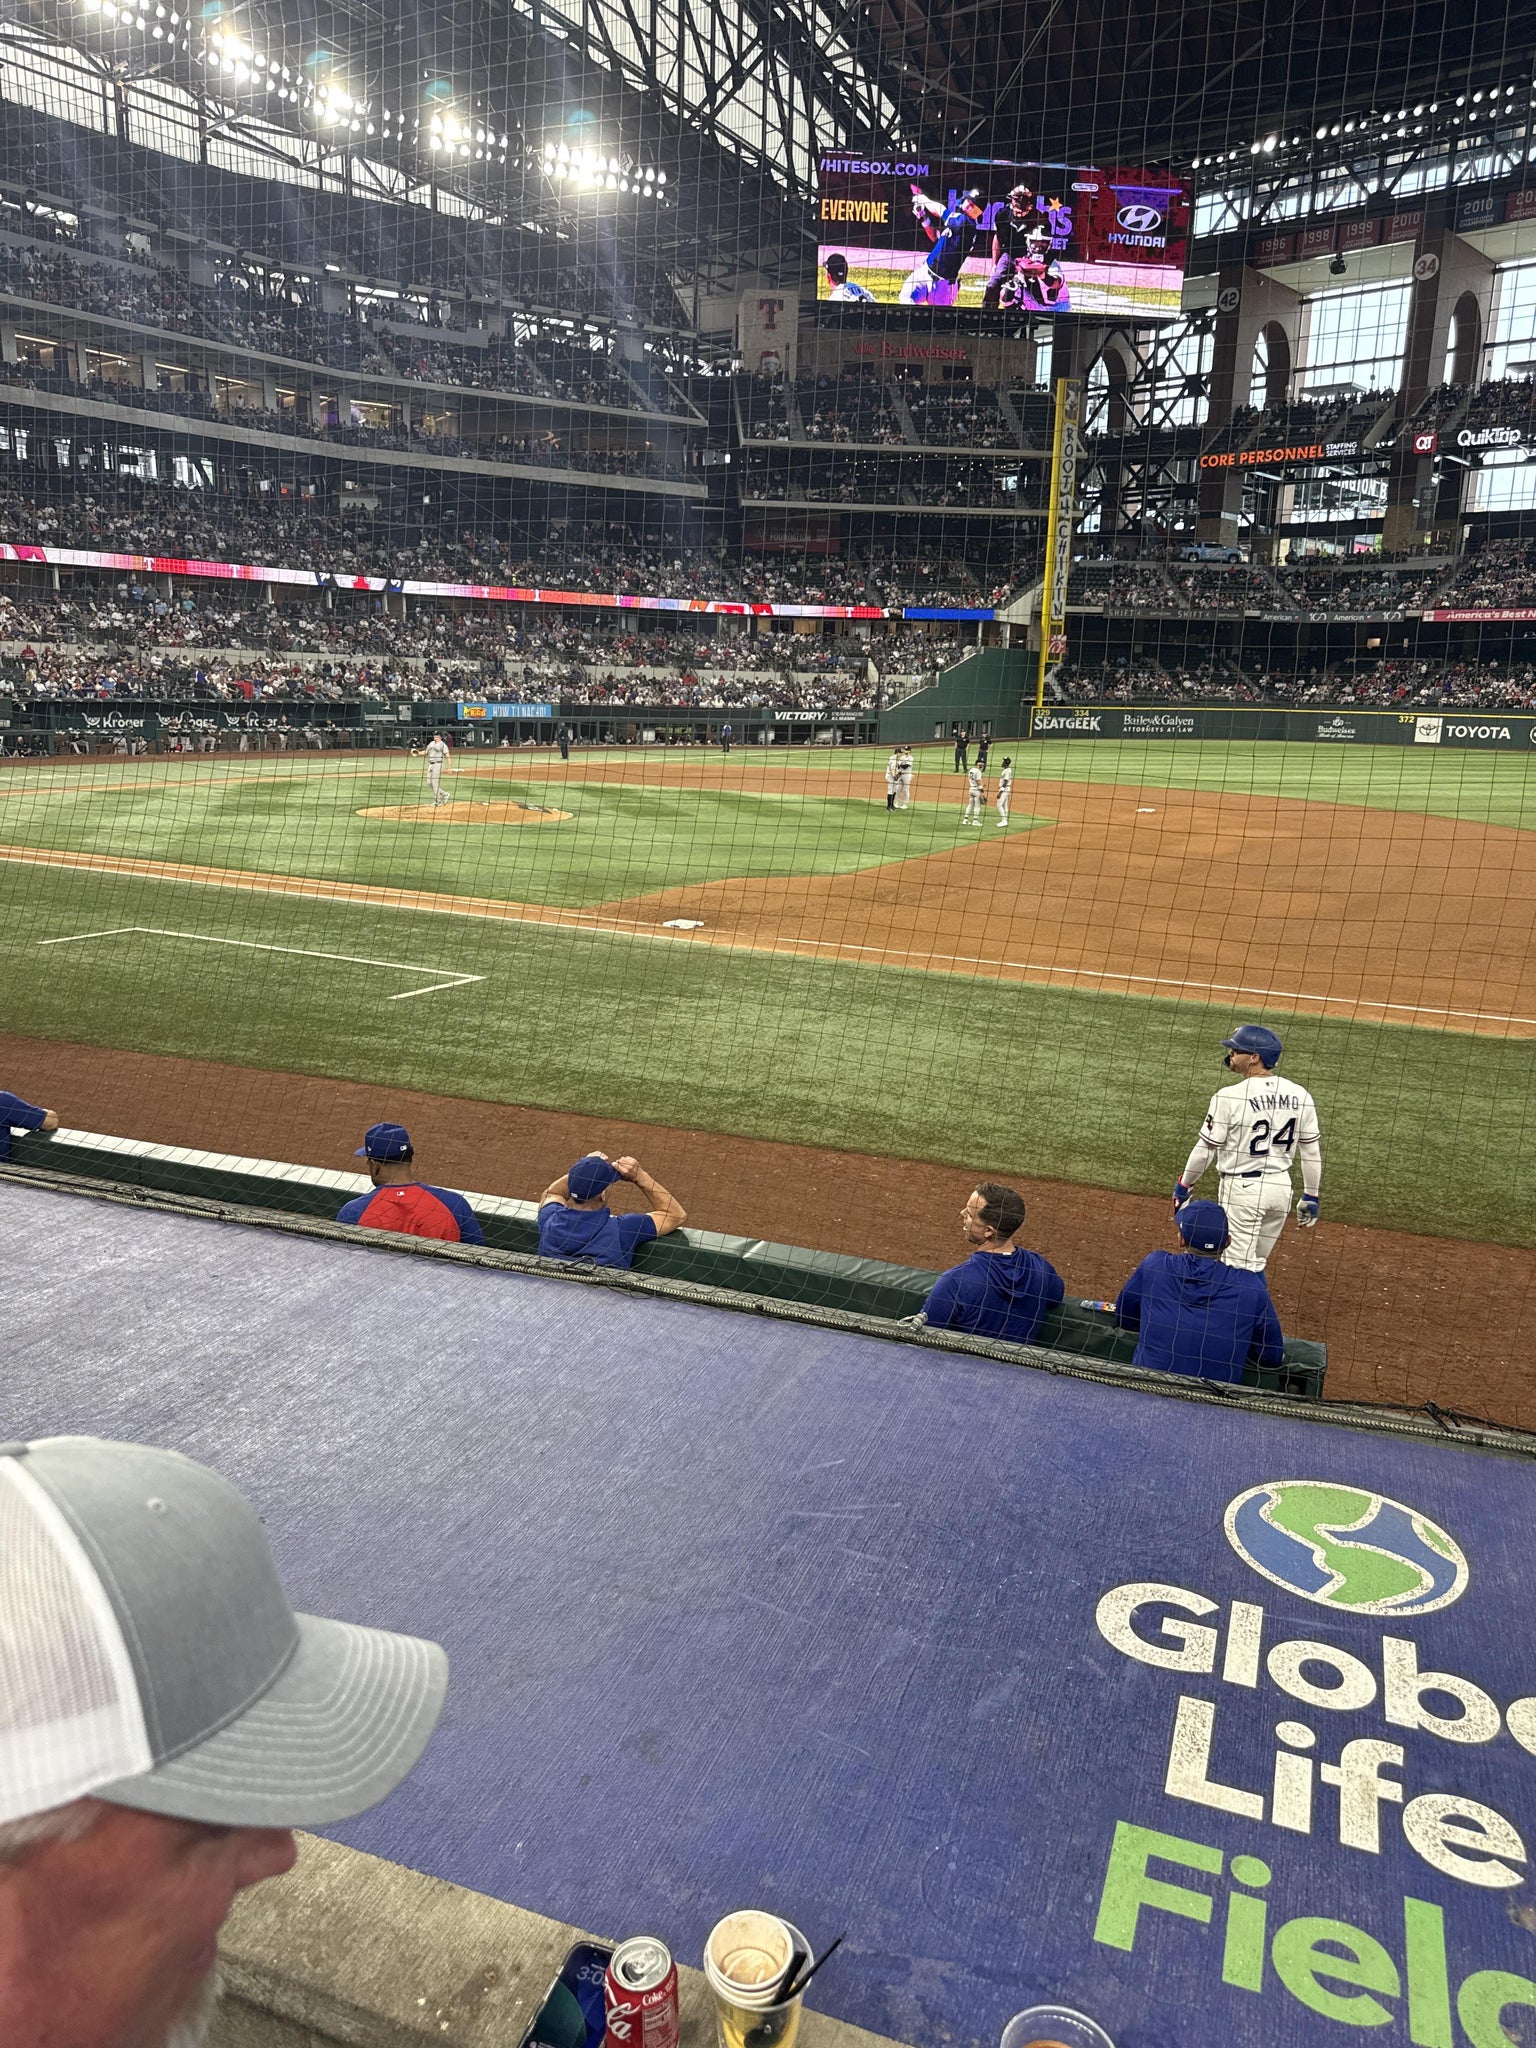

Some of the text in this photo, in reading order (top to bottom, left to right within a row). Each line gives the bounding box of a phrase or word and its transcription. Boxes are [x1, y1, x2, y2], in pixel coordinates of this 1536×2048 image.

[821, 198, 889, 223] EVERYONE
[1464, 198, 1493, 215] 2010
[1392, 212, 1420, 228] 2010
[1346, 221, 1373, 236] 1999
[1108, 233, 1166, 248] HYUNDAI
[1304, 229, 1330, 244] 1998
[1262, 238, 1286, 253] 1996
[1416, 257, 1437, 276] 34
[1220, 291, 1237, 307] 42
[1326, 442, 1357, 450] STAFFING
[1416, 435, 1435, 451] QT
[1200, 445, 1325, 468] CORE PERSONNEL
[1326, 449, 1356, 457] SERVICES
[1446, 610, 1500, 619] America's
[1501, 610, 1527, 618] Best
[103, 713, 145, 728] Kroger
[774, 711, 825, 720] VICTORY
[1074, 709, 1090, 717] 334
[1398, 715, 1415, 724] 372
[1033, 716, 1102, 731] SEATGEEK
[1446, 725, 1511, 739] TOYOTA
[1249, 1094, 1299, 1112] NIMMO
[1249, 1117, 1298, 1156] 24
[1095, 1581, 1536, 1758] Glob
[1165, 1695, 1527, 1888] Life
[576, 1966, 606, 1988] 3:0
[642, 1990, 663, 2006] Coke
